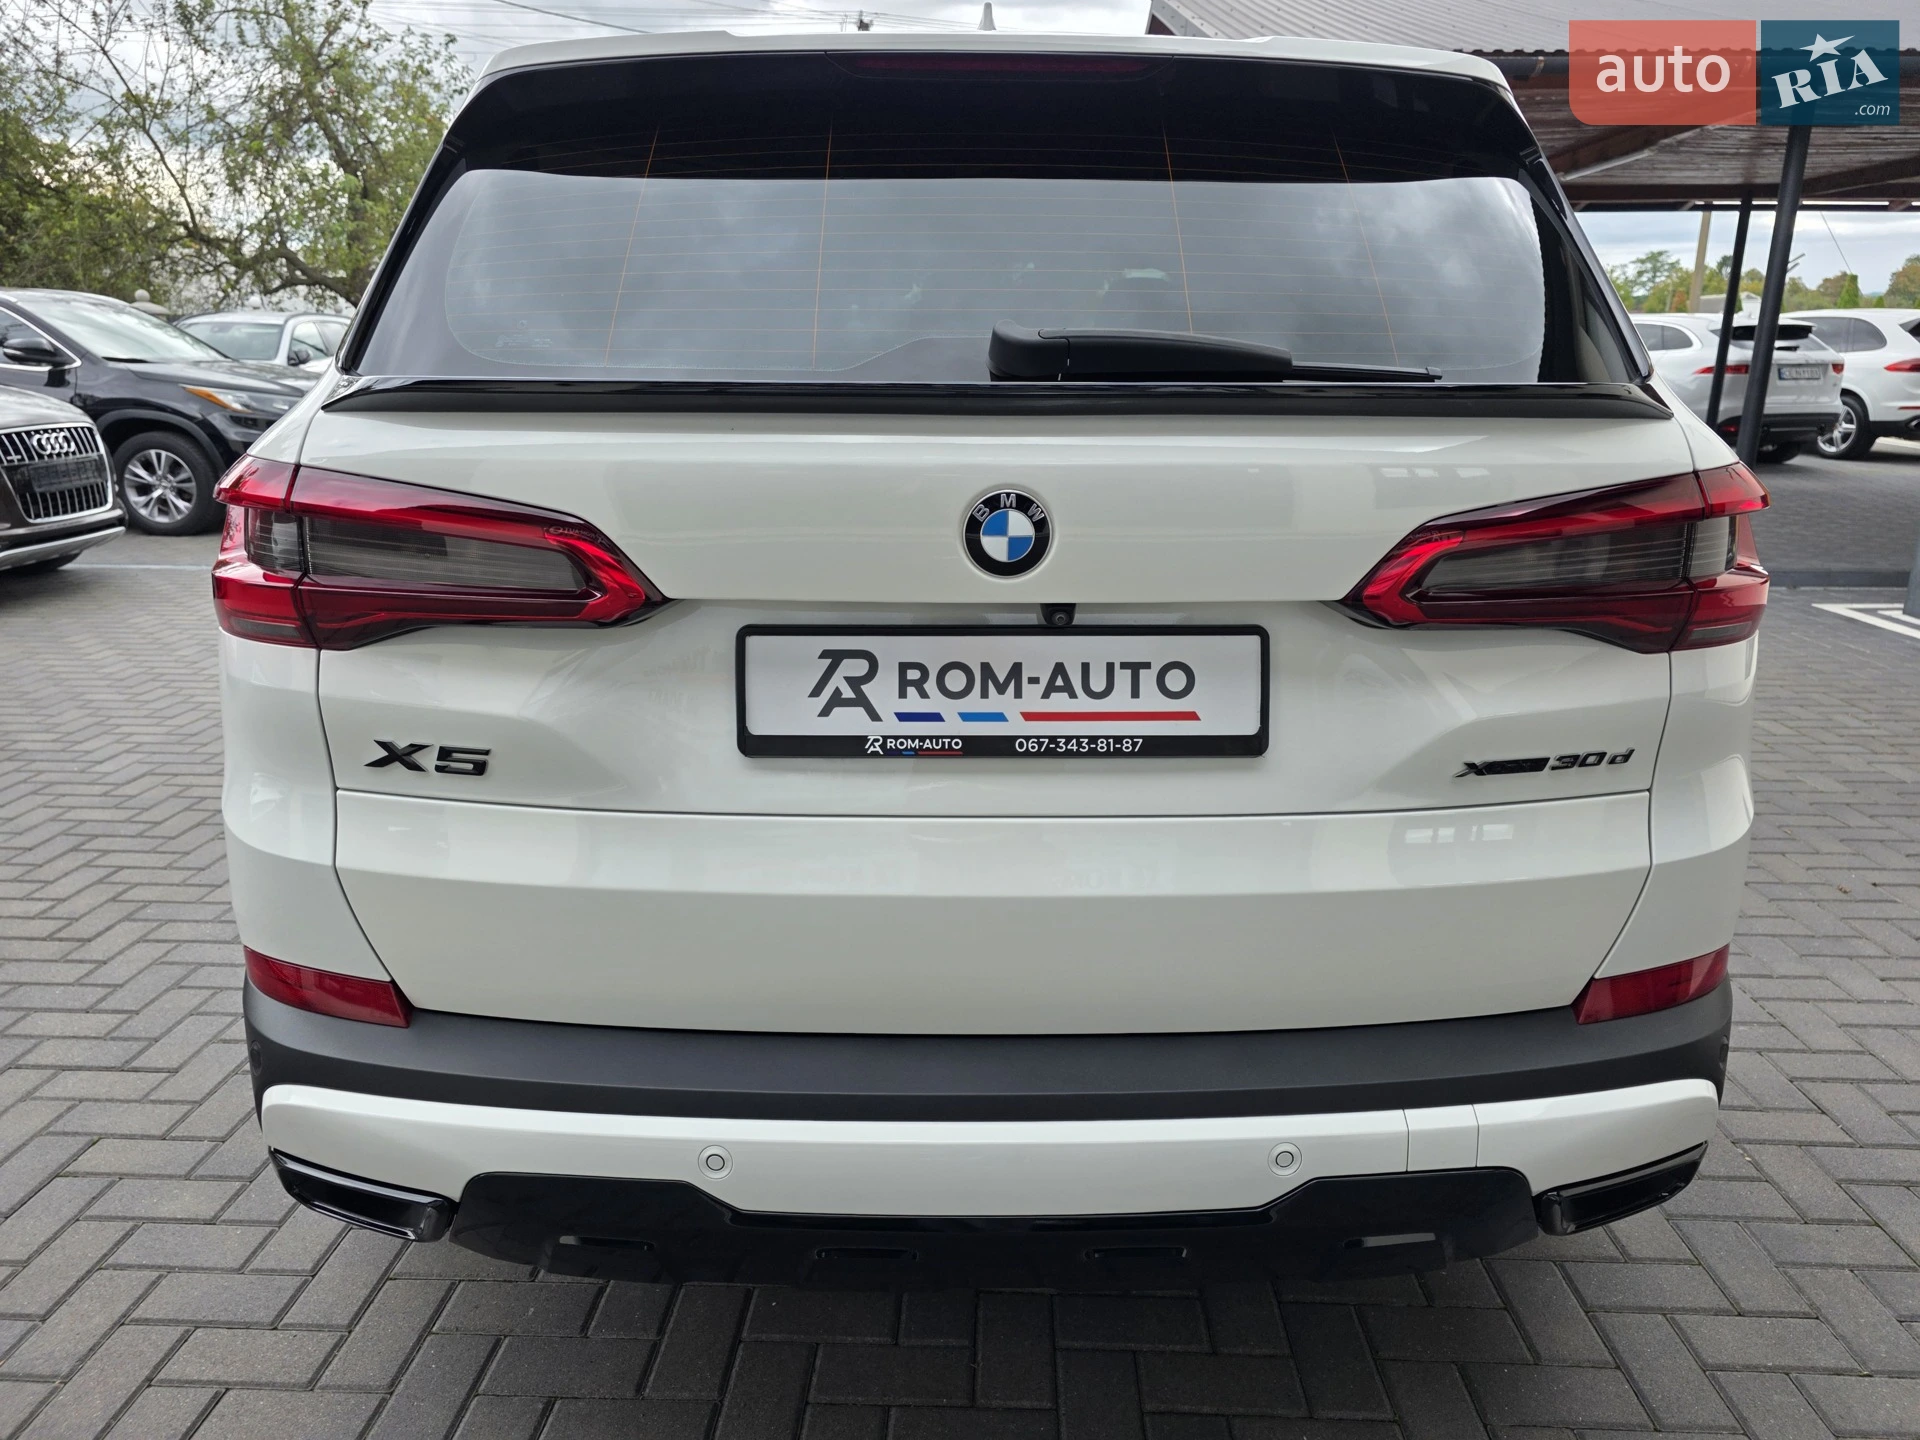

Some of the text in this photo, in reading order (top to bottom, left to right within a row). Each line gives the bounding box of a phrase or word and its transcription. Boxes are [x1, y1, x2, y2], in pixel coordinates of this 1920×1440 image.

[972, 493, 1045, 522] BMW
[897, 660, 1197, 700] ROM-AUTO
[363, 739, 492, 776] X5
[887, 738, 963, 750] ROM-AUTO
[1015, 738, 1144, 753] 067-343-81-87
